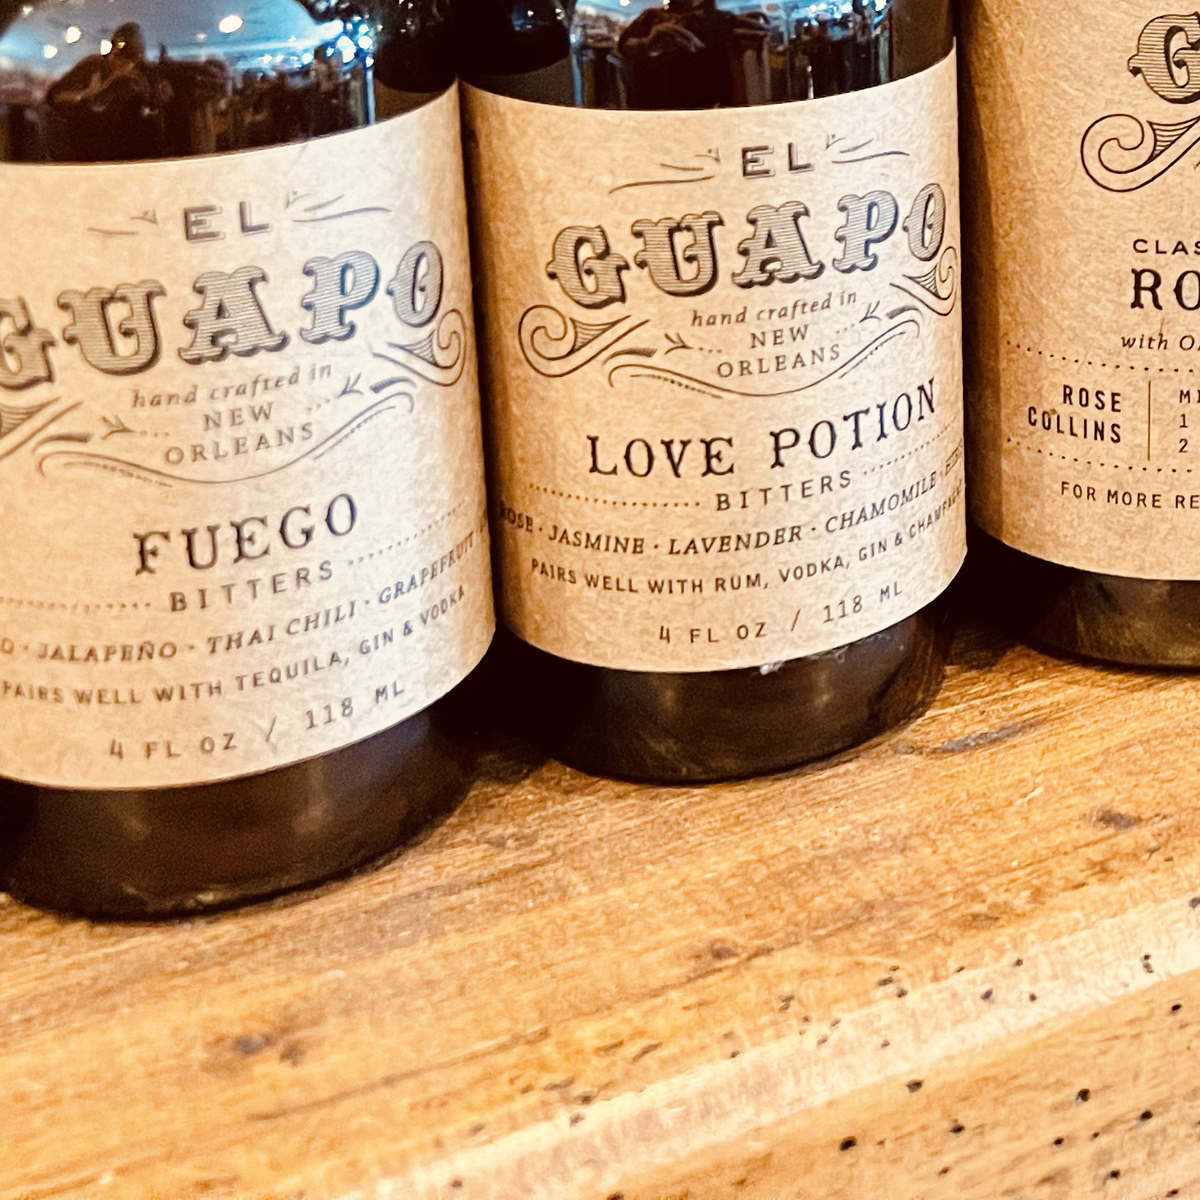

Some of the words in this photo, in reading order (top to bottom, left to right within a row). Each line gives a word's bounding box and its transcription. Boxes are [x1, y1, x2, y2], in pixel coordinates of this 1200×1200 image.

[742, 140, 815, 179] EL
[183, 200, 273, 242] EL
[546, 182, 947, 310] GUAPO
[0, 239, 446, 392] GUAPO
[691, 306, 746, 329] hand
[756, 295, 833, 324] crafted
[838, 288, 858, 307] in
[750, 325, 810, 350] NEW
[1120, 330, 1169, 352] with
[717, 343, 842, 380] ORLEANS
[131, 382, 198, 410] hand
[209, 368, 301, 402] crafted
[310, 362, 334, 383] in
[1062, 383, 1123, 413] ROSE
[202, 402, 276, 431] NEW
[587, 433, 735, 479] LOVE
[769, 375, 936, 471] POTION
[1027, 406, 1123, 445] COLLINS
[1178, 413, 1189, 430] 1
[165, 421, 315, 466] ORLEANS
[1178, 438, 1189, 455] 2
[548, 524, 645, 555] JASMINE
[667, 524, 803, 556] LAVENDER
[824, 469, 937, 534] CHAMOMILE
[715, 469, 853, 512] BITTERS
[1060, 480, 1097, 502] FOR
[1107, 489, 1163, 509] MORE
[133, 492, 359, 577] FUEGO
[530, 557, 578, 585] PAIRS
[584, 573, 639, 594] WELL
[647, 578, 704, 596] WITH
[714, 571, 769, 591] RUM,
[777, 554, 850, 584] VODKA,
[857, 537, 888, 563] GIN
[893, 531, 904, 548] &
[169, 559, 334, 613] BITTERS
[206, 624, 278, 655] THAI
[285, 598, 358, 637] CHILI
[377, 528, 475, 605] GRAPEFRUIT
[658, 624, 672, 646] 4
[689, 627, 720, 644] FL
[736, 620, 768, 642] OZ
[822, 594, 864, 625] 118
[879, 580, 904, 604] ML
[2, 679, 64, 705] PAIRS
[73, 687, 142, 706] WELL
[152, 679, 223, 703] WITH
[234, 650, 350, 693] TEQUILA,
[358, 627, 395, 656] GIN
[402, 620, 414, 638] &
[418, 584, 466, 627] VODKA
[108, 737, 125, 761] 4
[143, 739, 182, 760] FL
[199, 731, 238, 755] OZ
[304, 695, 355, 731] 118
[374, 678, 406, 707] ML
